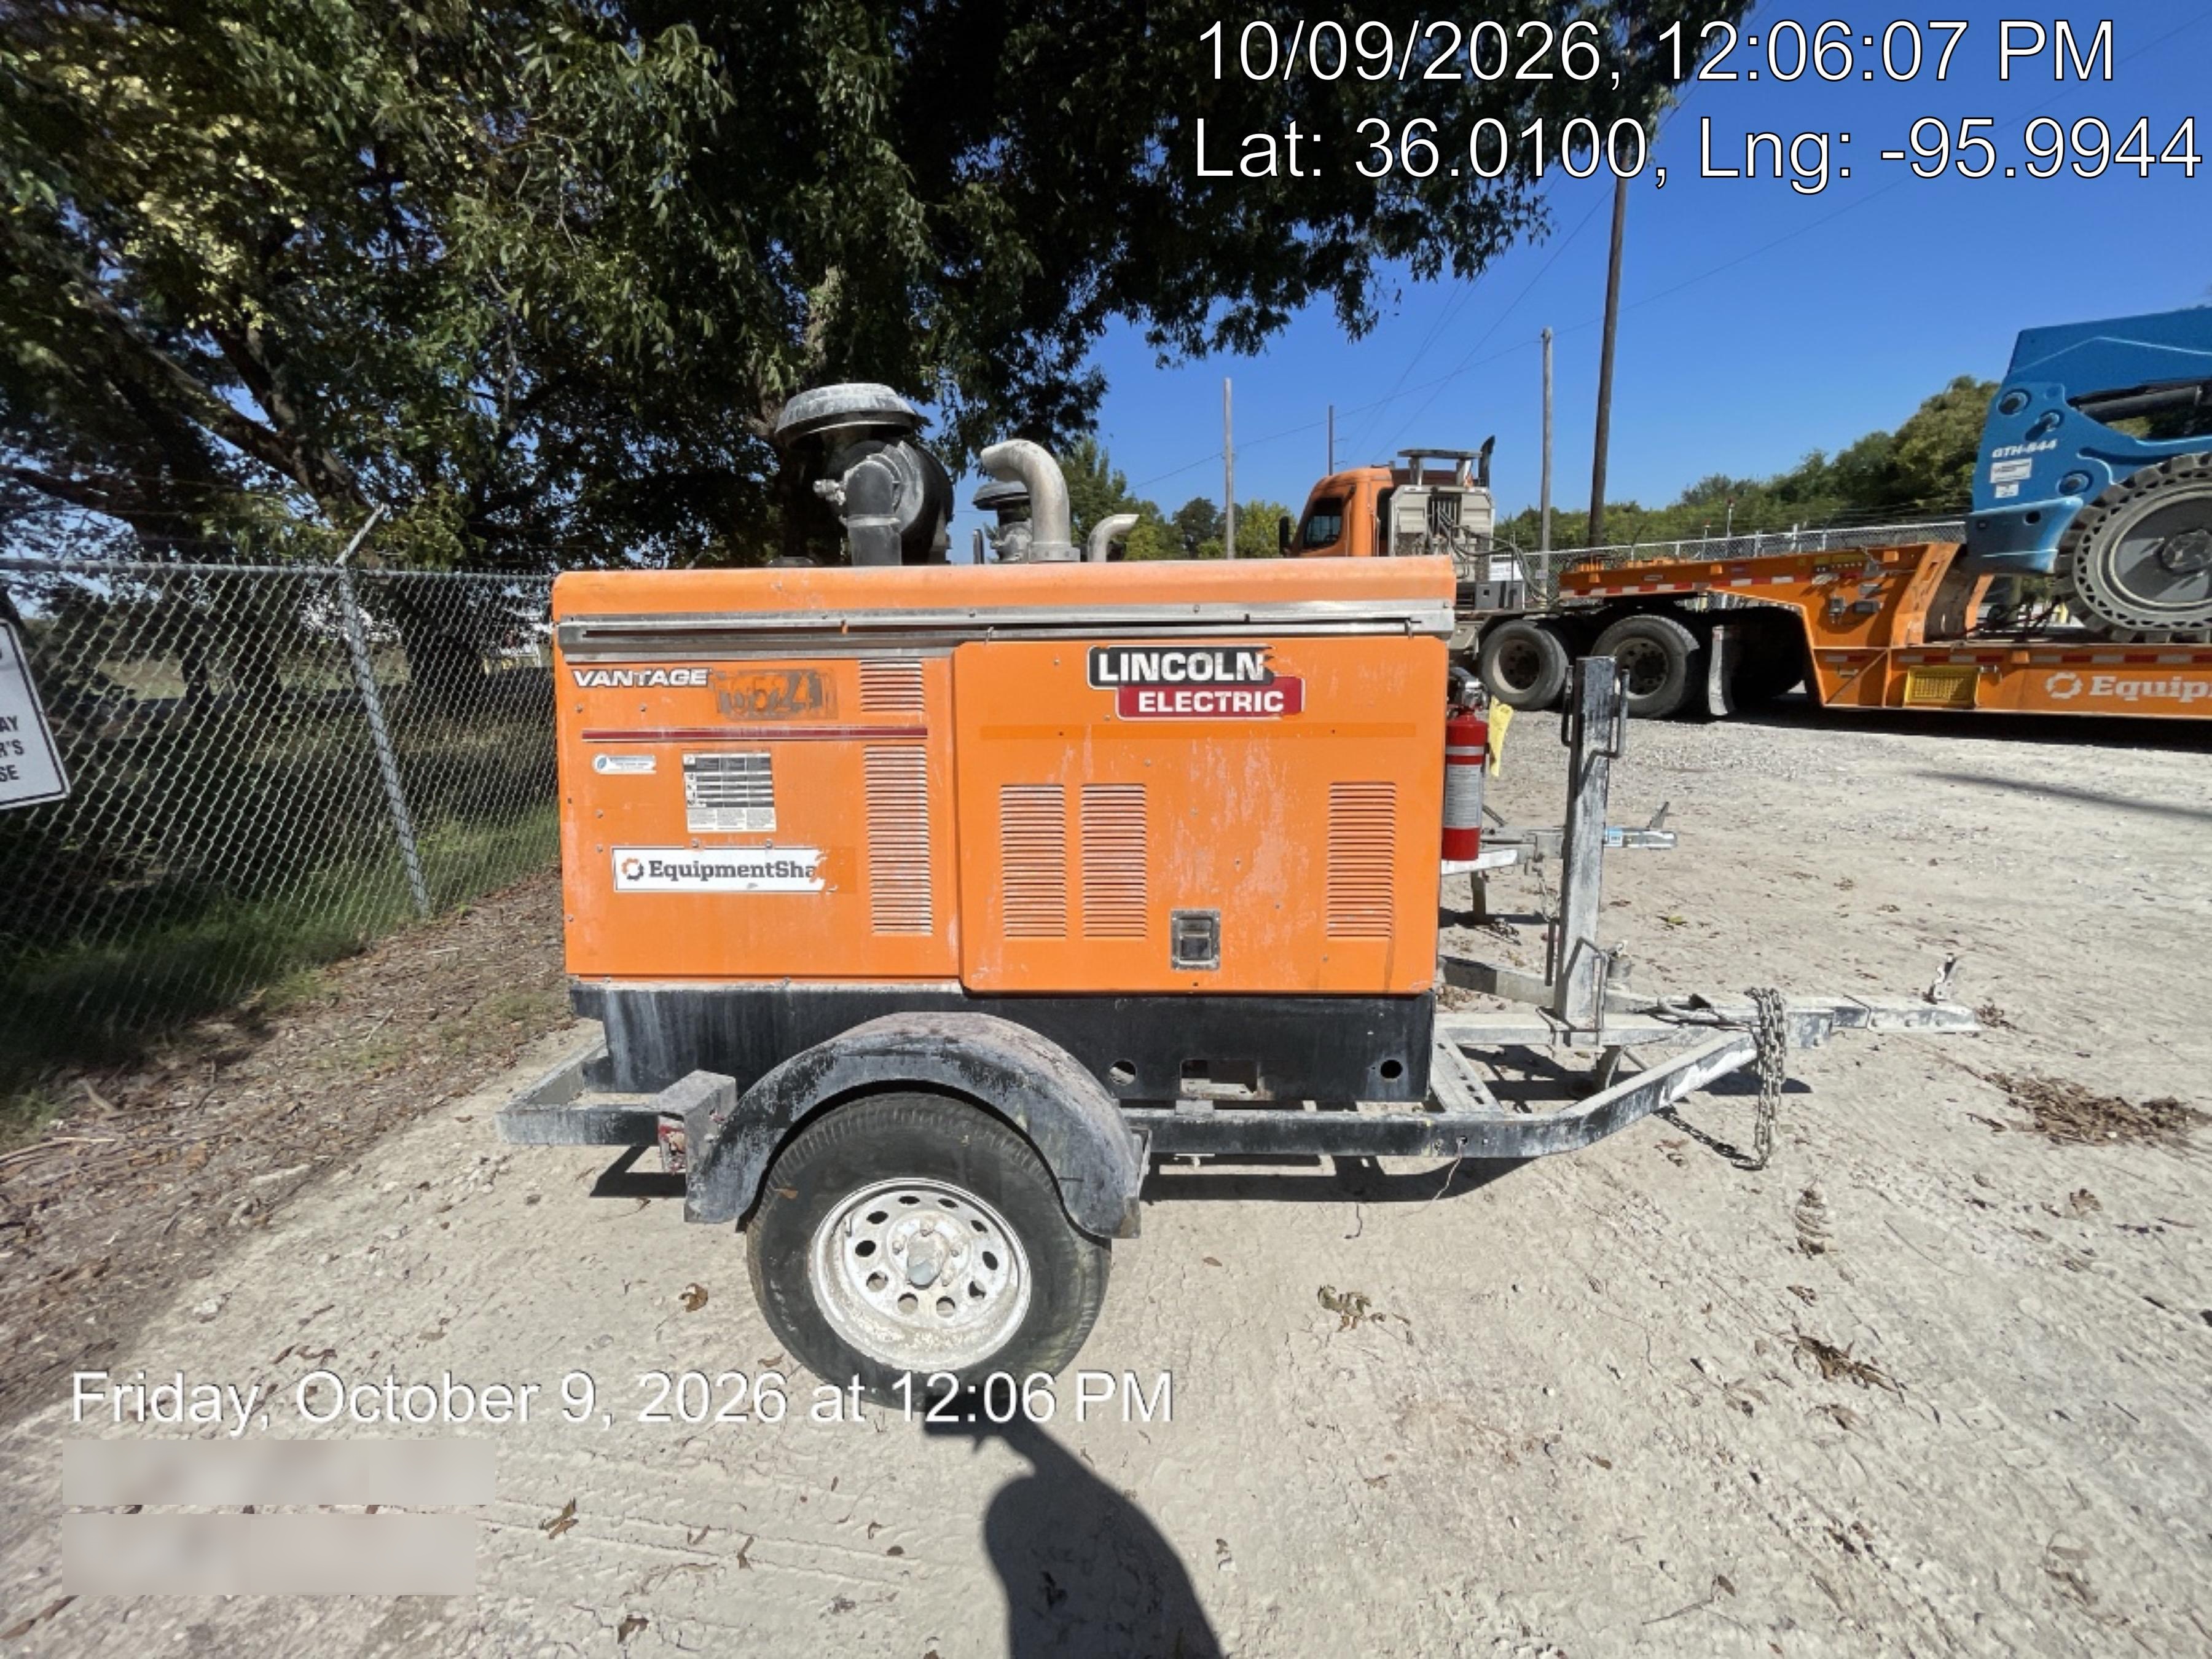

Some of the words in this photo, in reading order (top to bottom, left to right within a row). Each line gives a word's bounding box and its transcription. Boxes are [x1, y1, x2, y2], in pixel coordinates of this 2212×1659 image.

[572, 667, 708, 687] VANTAGE
[1099, 652, 1264, 681] LINCOLN
[1139, 691, 1284, 712] ELECTRIC
[2089, 676, 2212, 703] Equip
